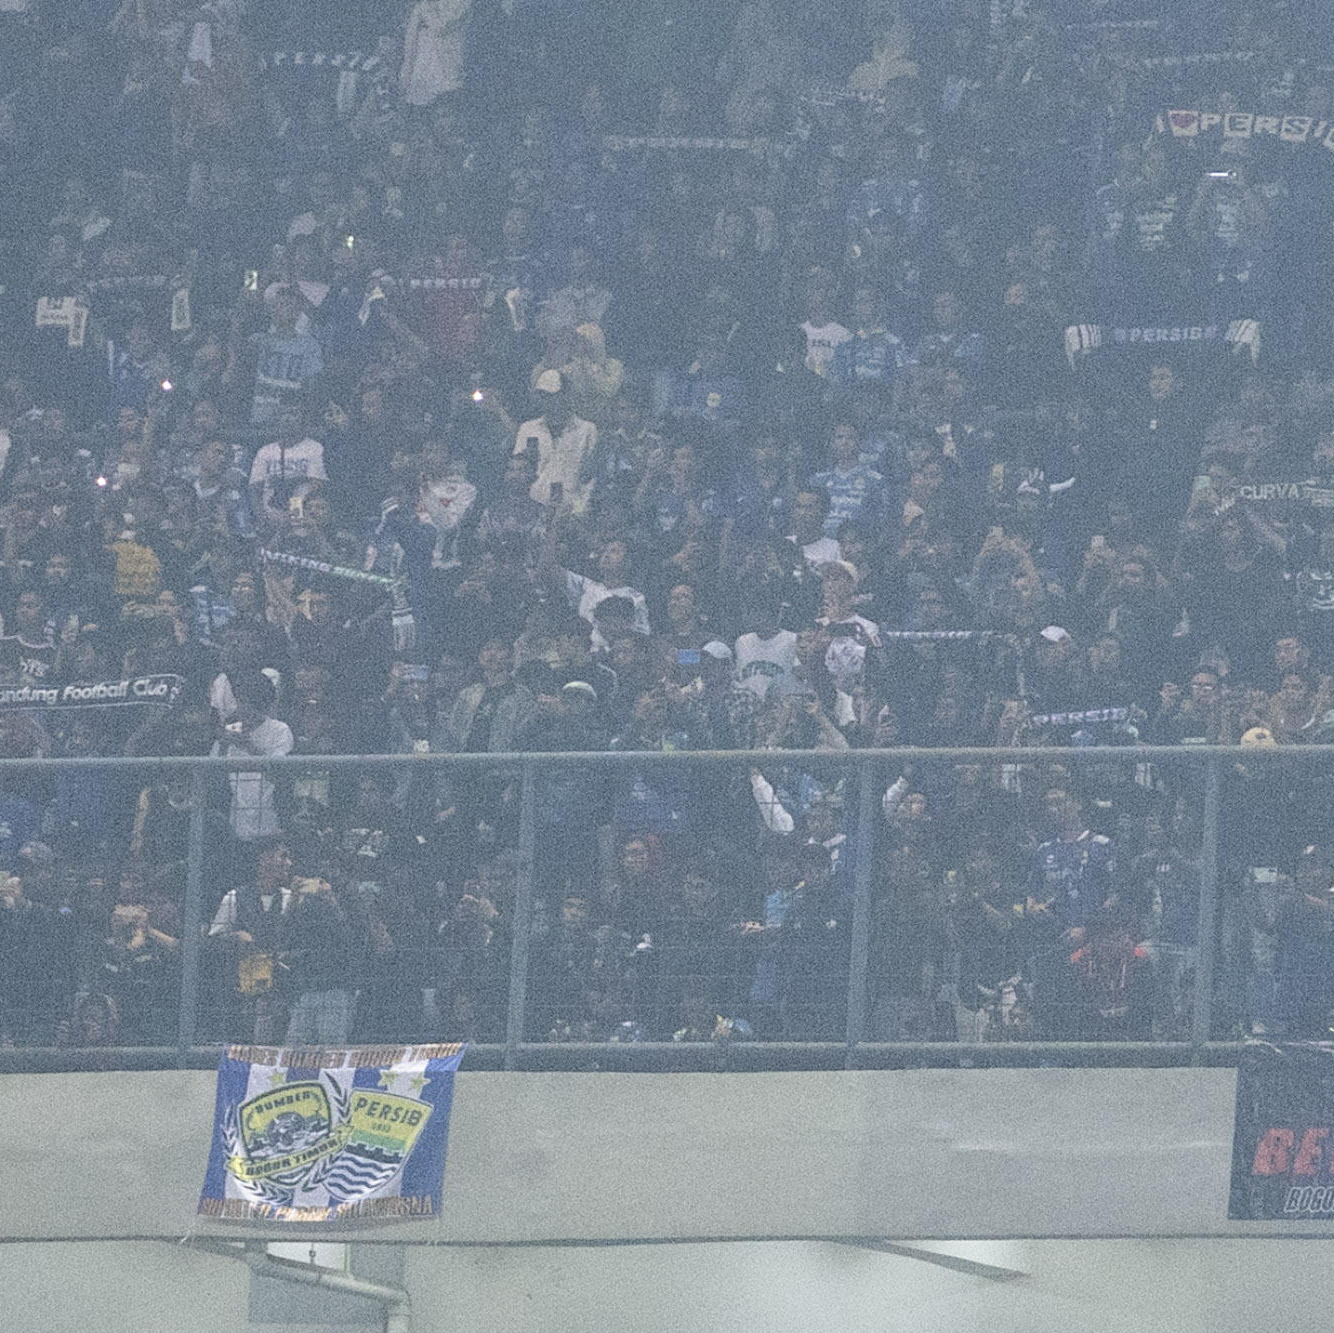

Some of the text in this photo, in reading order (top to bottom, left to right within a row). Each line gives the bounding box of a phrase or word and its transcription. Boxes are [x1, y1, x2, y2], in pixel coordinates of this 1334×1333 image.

[63, 680, 129, 700] Football
[133, 677, 168, 697] Club
[355, 1097, 424, 1128] PERSIB
